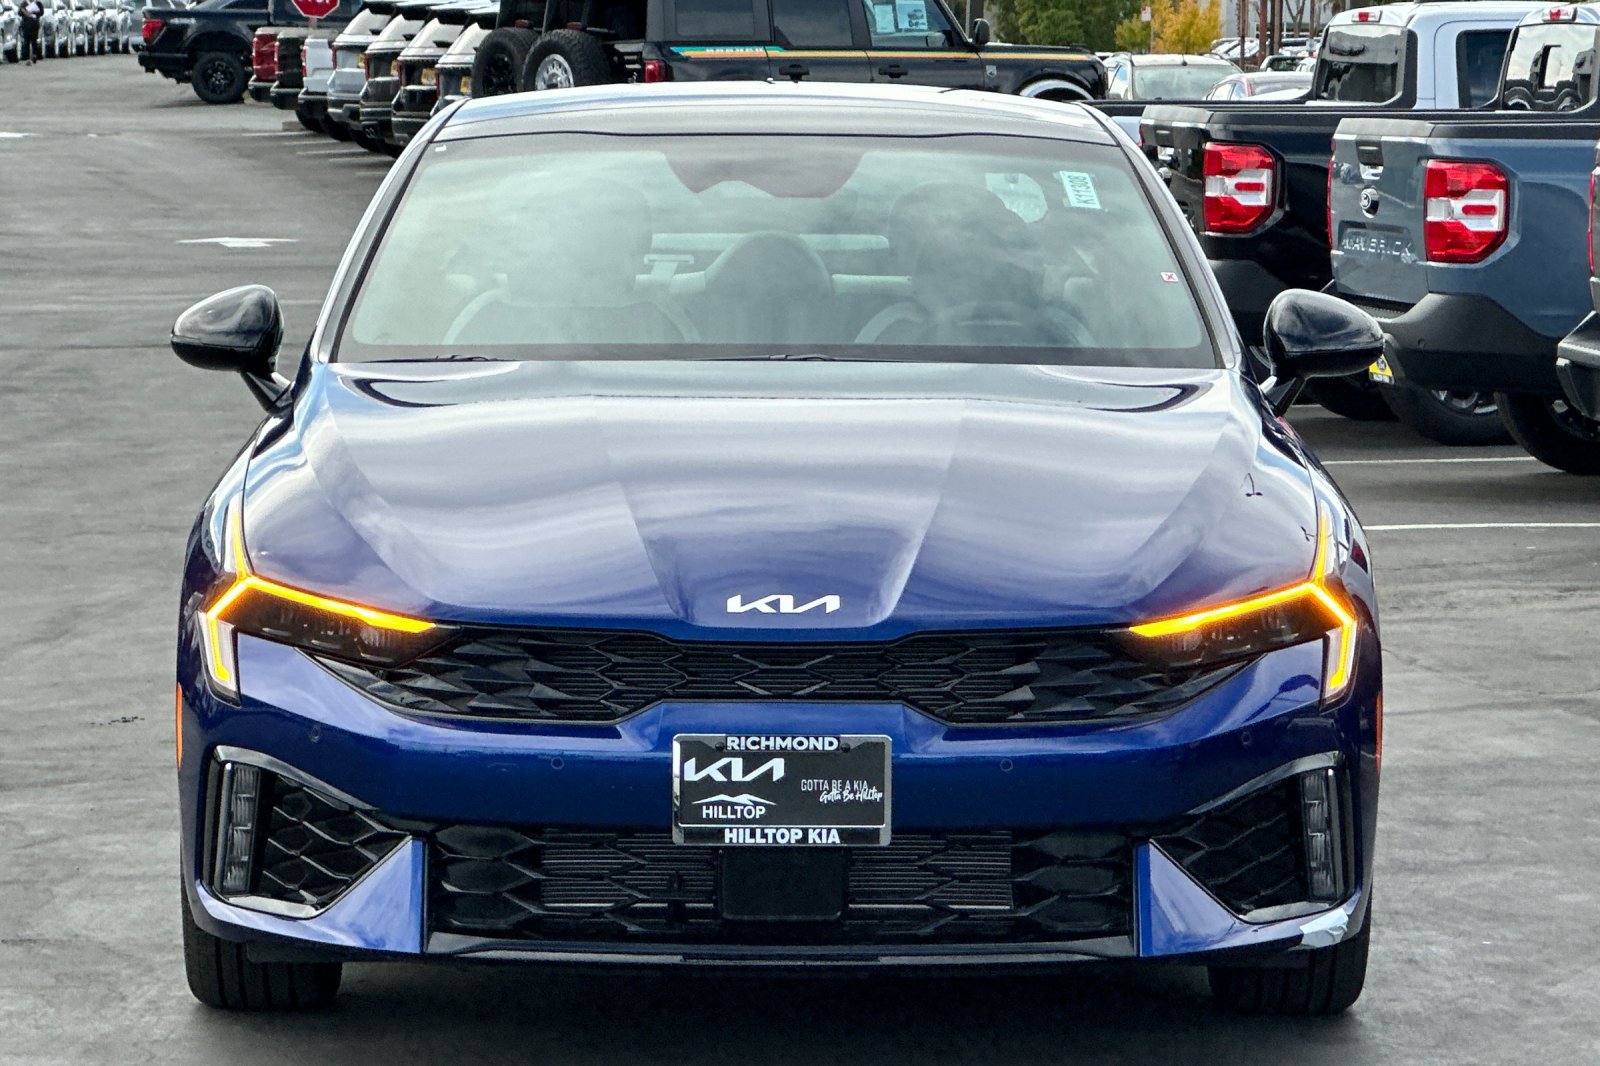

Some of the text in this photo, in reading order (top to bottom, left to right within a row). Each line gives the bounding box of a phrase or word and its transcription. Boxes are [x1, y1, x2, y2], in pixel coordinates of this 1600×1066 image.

[726, 594, 840, 613] KIA
[726, 736, 839, 751] RICHMOND
[683, 757, 785, 782] KIA
[800, 779, 869, 791] GOTTA BE A KIA
[819, 785, 883, 803] Gotta Be Hilltop
[702, 806, 766, 819] HILLTOP
[724, 828, 841, 844] HILLTOP KIA
